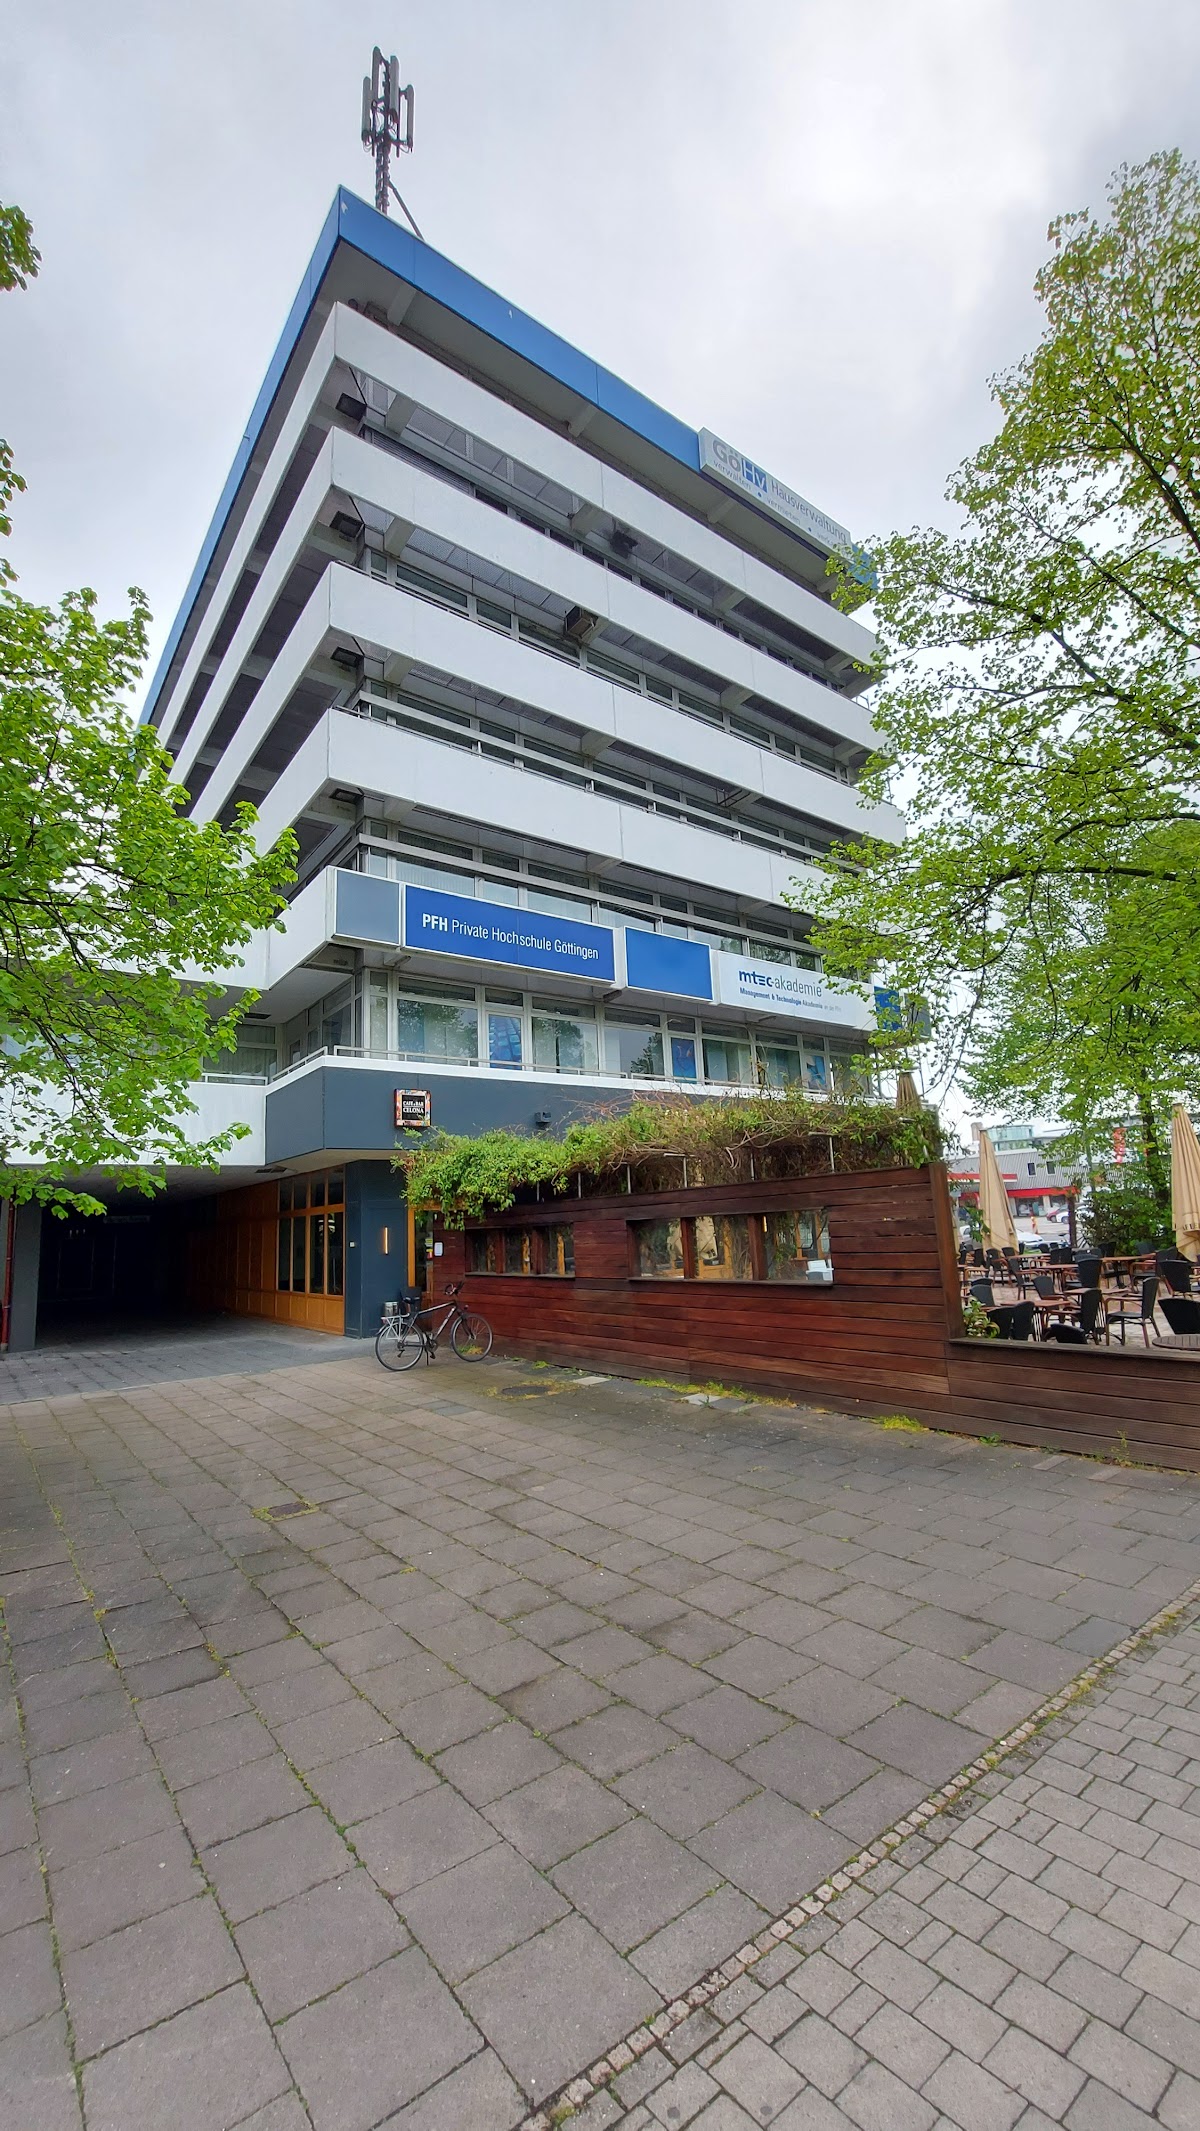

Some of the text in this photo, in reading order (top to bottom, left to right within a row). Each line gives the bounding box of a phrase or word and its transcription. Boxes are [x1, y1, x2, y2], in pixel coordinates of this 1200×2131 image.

[713, 460, 752, 491] verwalten
[766, 496, 801, 526] vermieten
[771, 479, 847, 545] Hausverwaltung
[422, 913, 599, 960] PFH Private Hochschule Göttingen
[739, 987, 770, 998] Management
[776, 994, 802, 1006] Technologie
